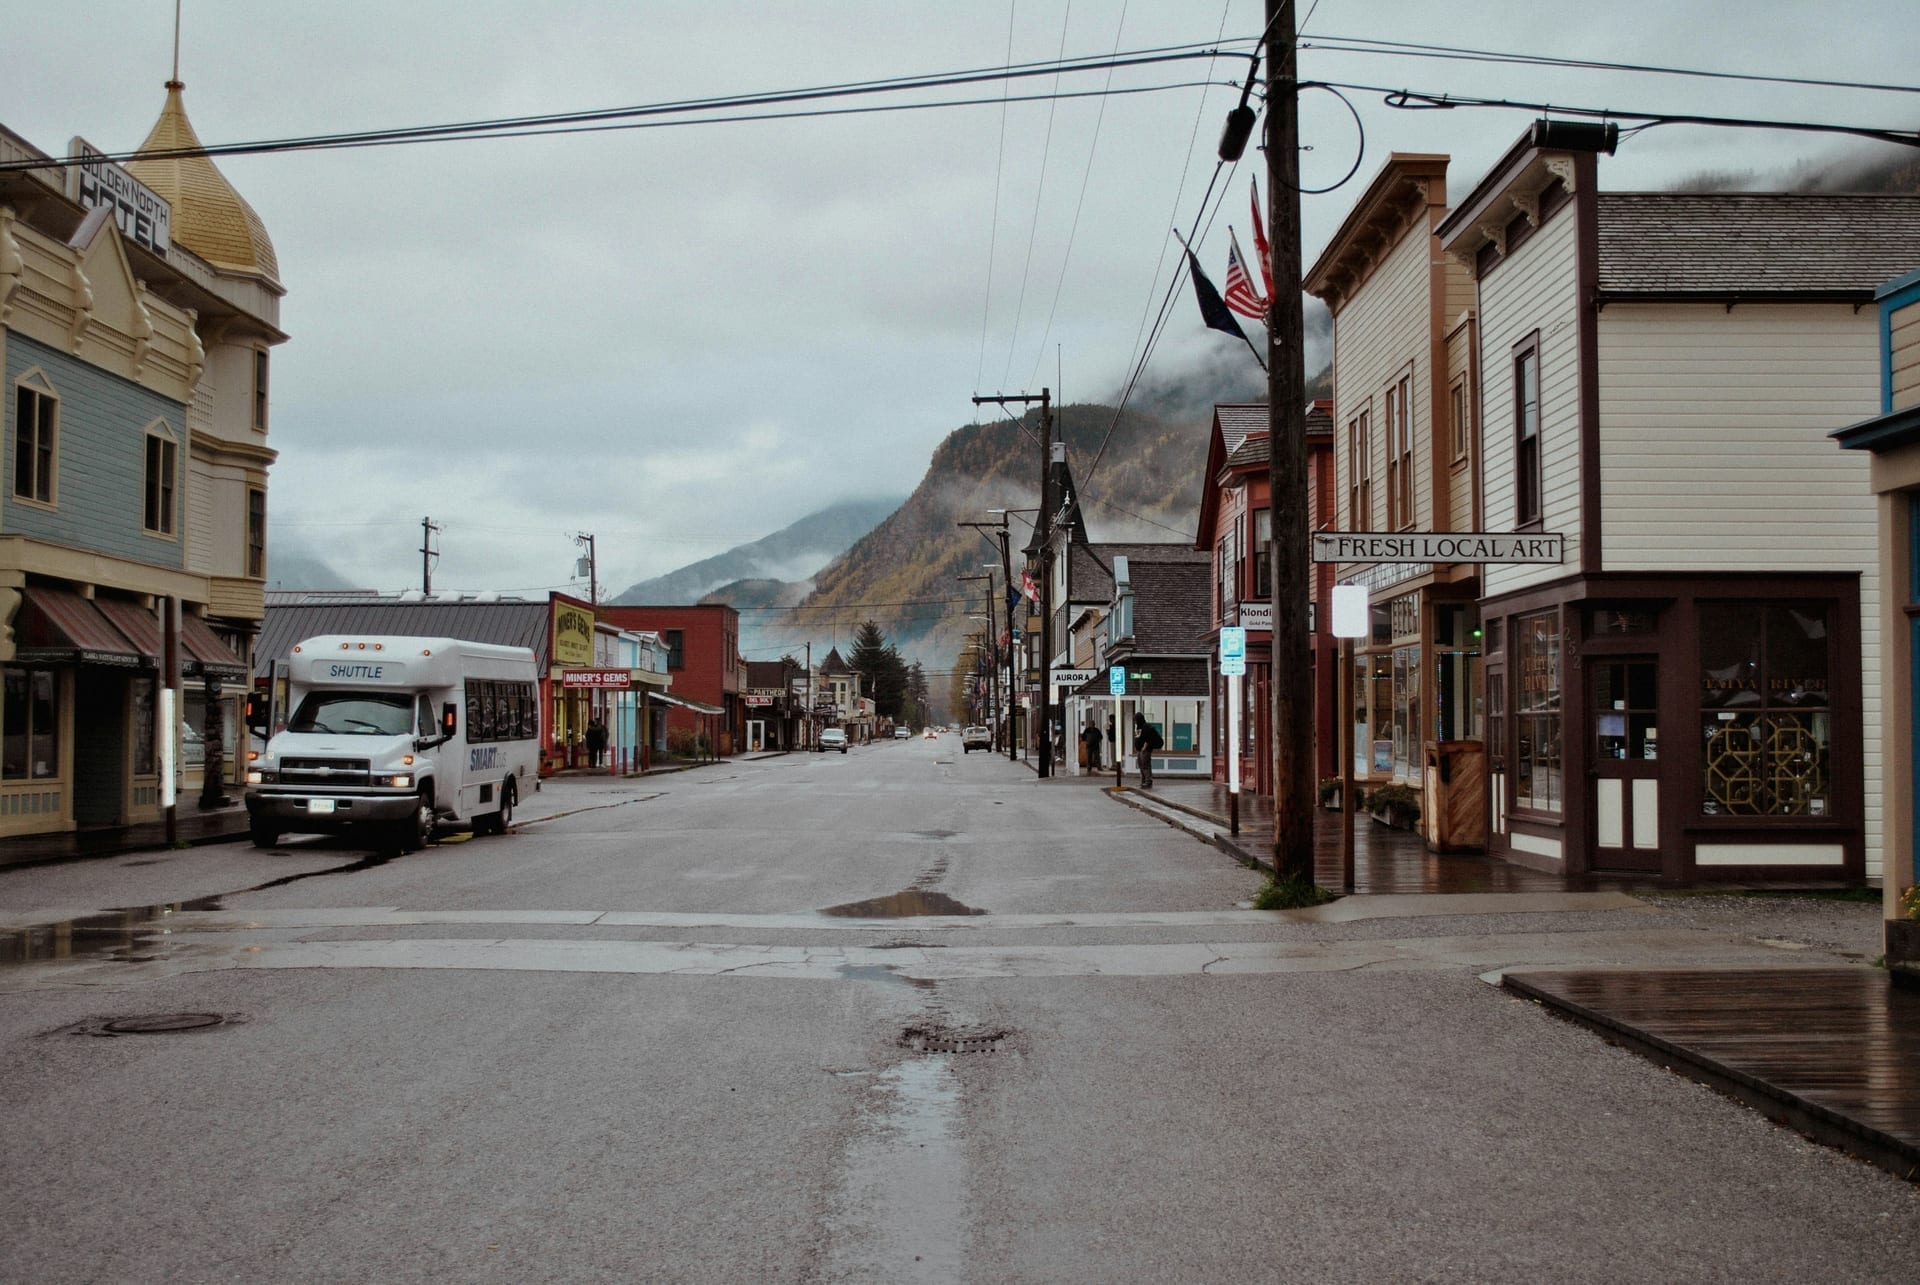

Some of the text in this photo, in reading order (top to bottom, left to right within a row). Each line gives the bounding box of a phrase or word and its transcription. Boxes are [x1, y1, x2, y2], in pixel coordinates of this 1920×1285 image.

[131, 181, 168, 226] NORTH
[1337, 538, 1557, 558] FRESH LOCAL ART
[1240, 607, 1272, 617] Klondi
[330, 664, 383, 679] SHUTTLE
[1056, 673, 1090, 681] AURORA
[565, 673, 628, 683] MINER'S GEMS
